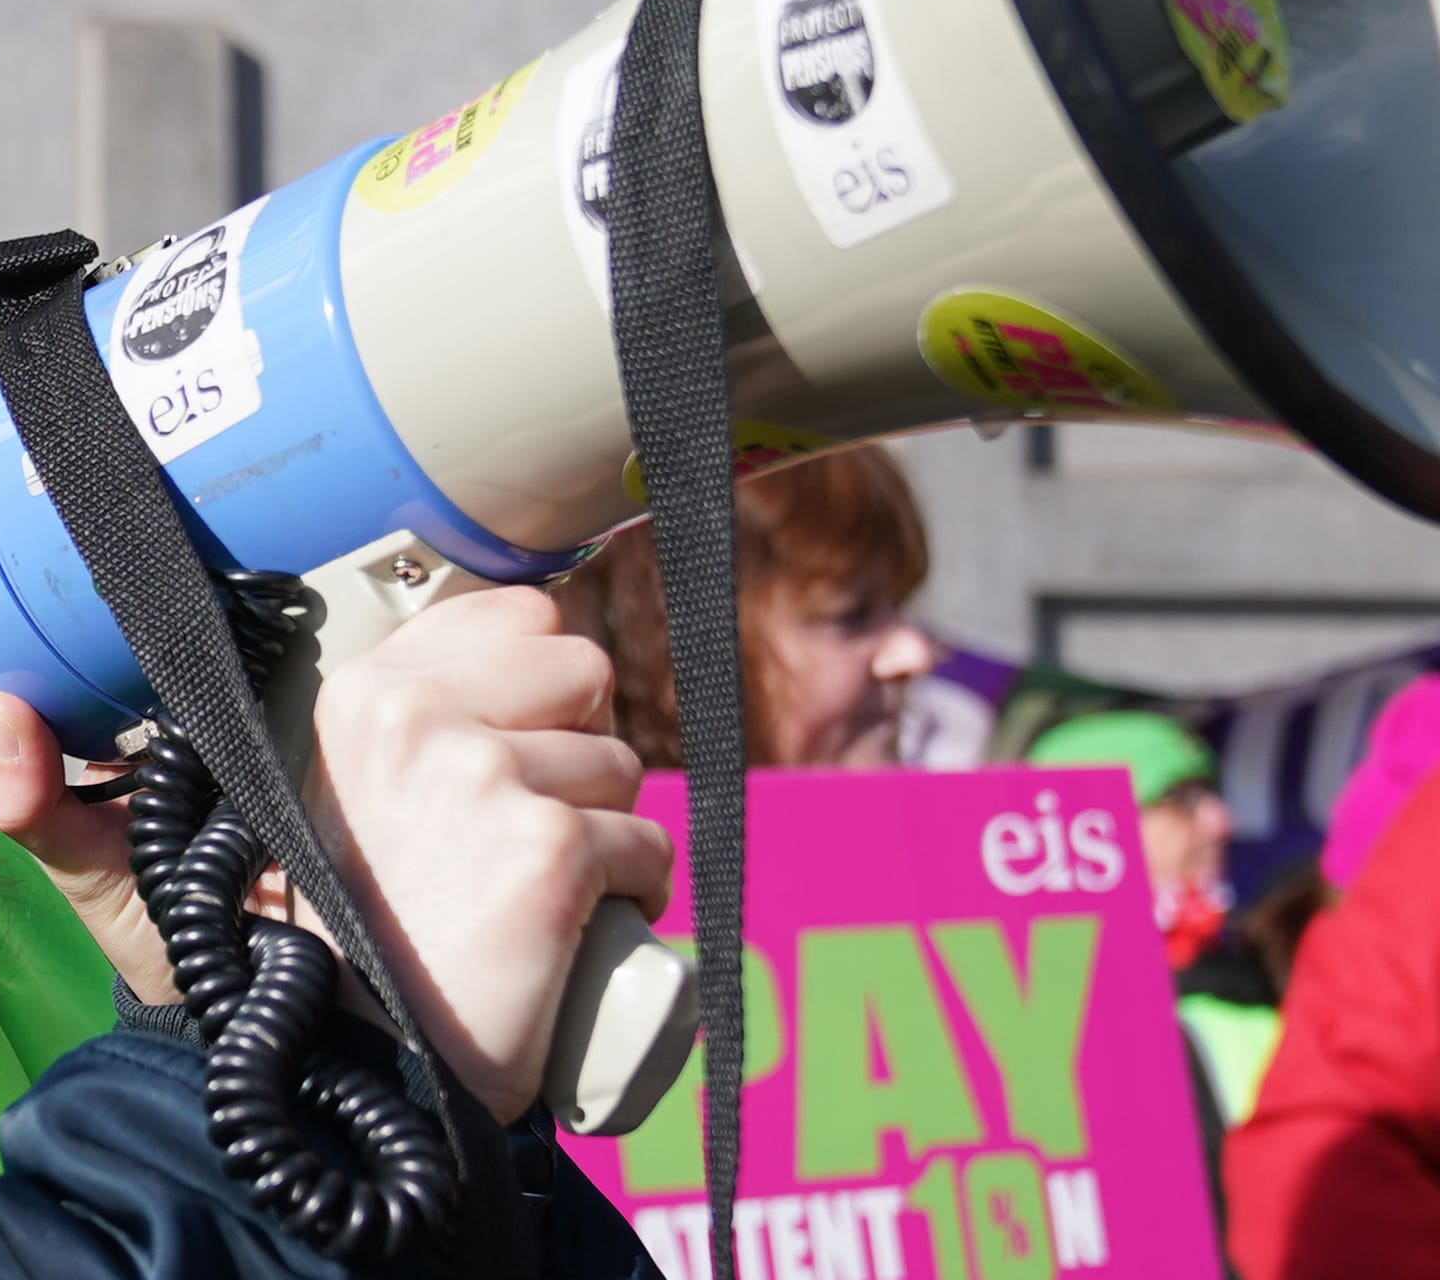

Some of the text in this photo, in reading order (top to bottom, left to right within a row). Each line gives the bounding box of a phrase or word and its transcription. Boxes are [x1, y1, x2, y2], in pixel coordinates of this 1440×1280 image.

[834, 141, 910, 214] eis
[149, 369, 222, 437] eis
[981, 792, 1125, 896] eis
[621, 914, 1101, 1196] PAY
